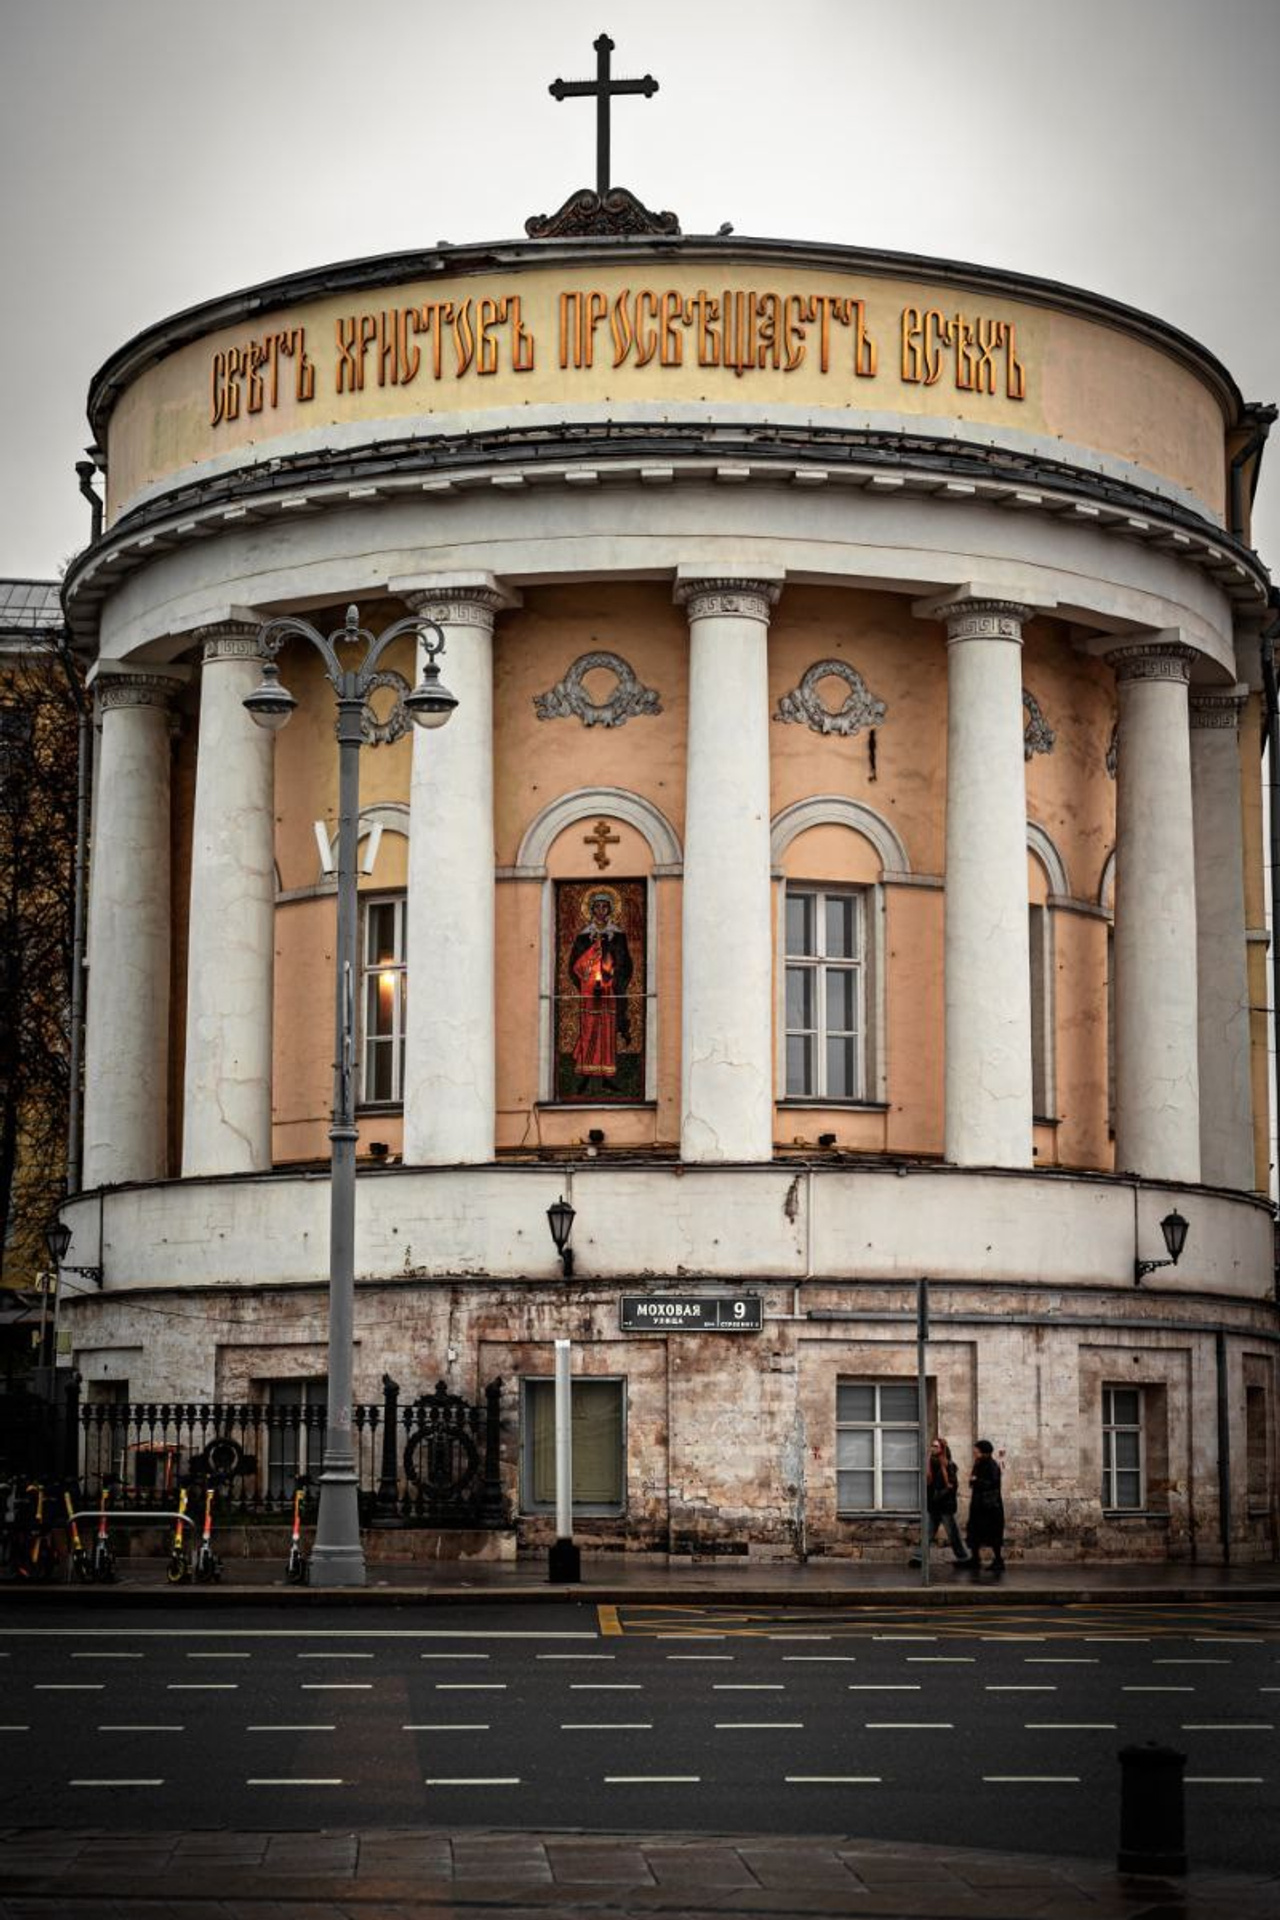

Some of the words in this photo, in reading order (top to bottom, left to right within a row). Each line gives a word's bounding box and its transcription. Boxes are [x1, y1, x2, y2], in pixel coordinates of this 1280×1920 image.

[637, 1304, 701, 1316] МОХОВАЯ
[733, 1302, 747, 1320] 9
[653, 1317, 684, 1325] УЛИЦА
